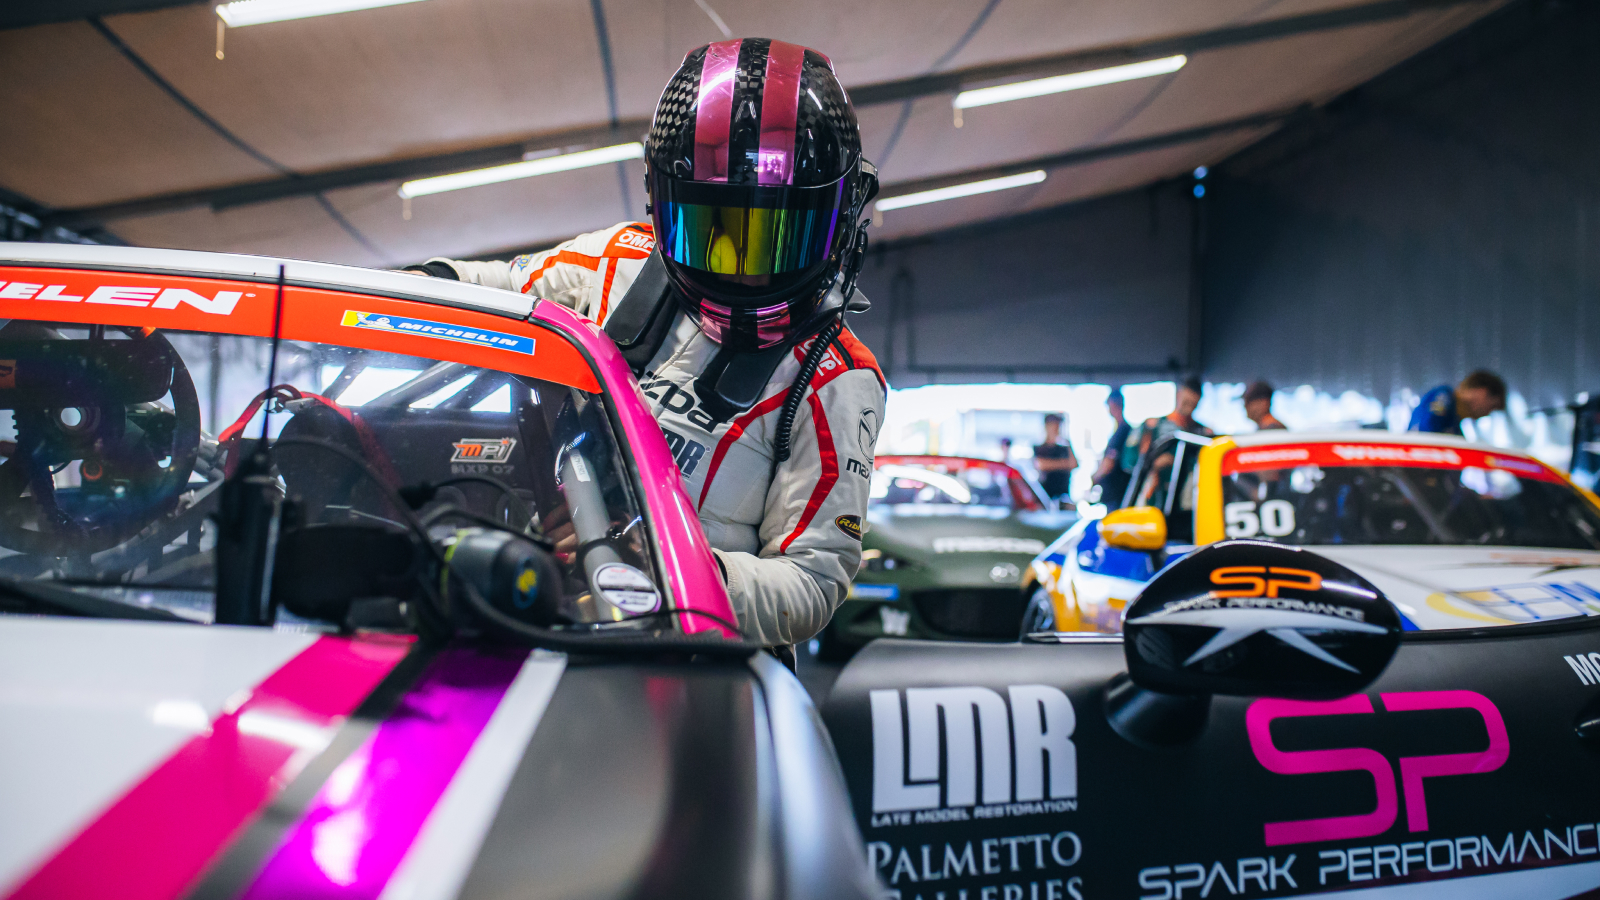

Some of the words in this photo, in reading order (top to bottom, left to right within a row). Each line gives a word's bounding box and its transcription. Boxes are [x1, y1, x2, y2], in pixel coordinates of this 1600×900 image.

[0, 281, 243, 315] ELEN
[398, 322, 518, 347] MICHELIN
[661, 427, 706, 475] MR
[1225, 500, 1296, 538] 50
[1210, 566, 1323, 598] SP
[1227, 598, 1365, 622] PERFORMANCE
[870, 684, 1078, 813] LMR
[1246, 690, 1510, 846] SP
[871, 813, 911, 827] LATE
[915, 808, 970, 824] MODEL
[974, 800, 1078, 819] RESTORATION
[866, 831, 1082, 885] PALMETTO
[1138, 854, 1298, 900] SPARK
[1319, 823, 1600, 885] PERFORMANC
